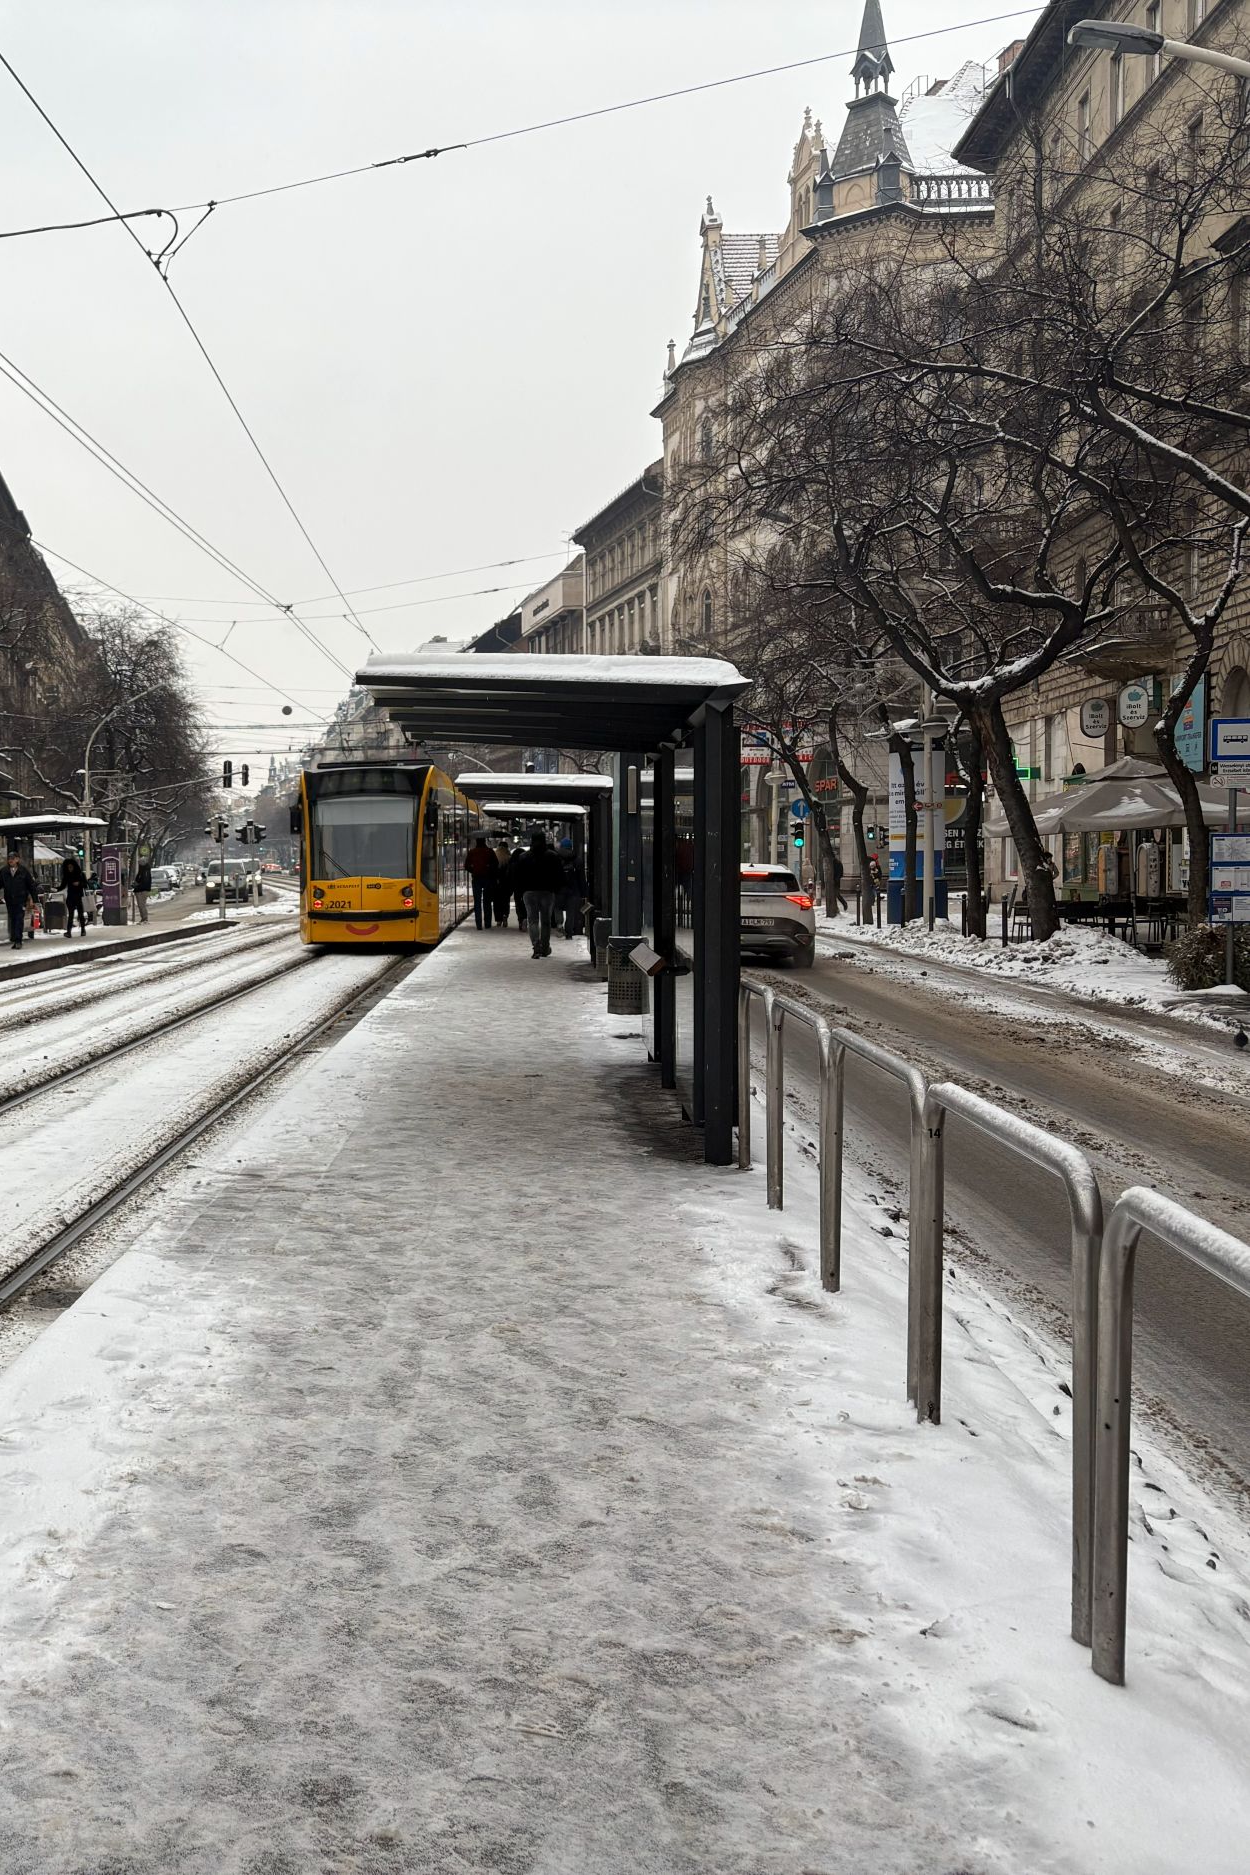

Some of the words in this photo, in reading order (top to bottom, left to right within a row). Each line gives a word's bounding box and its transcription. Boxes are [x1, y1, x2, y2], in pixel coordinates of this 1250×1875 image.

[814, 779, 837, 793] SPAR
[329, 900, 352, 909] 2021
[773, 1024, 782, 1032] 16
[927, 1127, 942, 1139] 14
